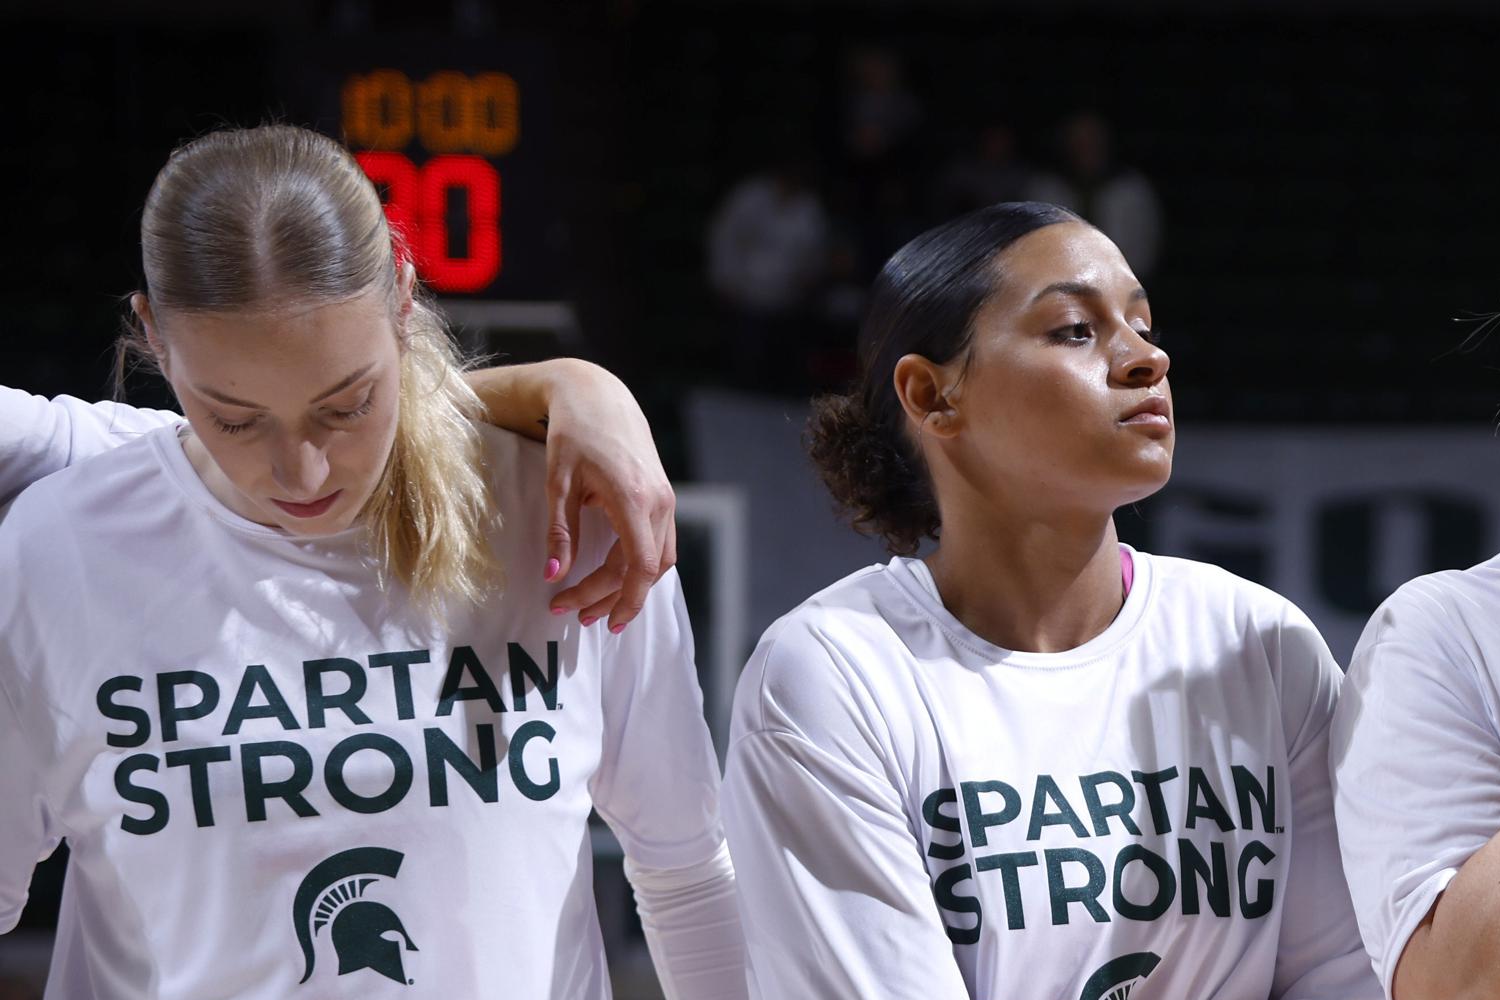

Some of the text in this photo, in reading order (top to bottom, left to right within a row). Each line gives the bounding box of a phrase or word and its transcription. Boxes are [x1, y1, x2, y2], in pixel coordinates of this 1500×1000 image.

[96, 641, 559, 747] SPARTAN
[114, 720, 561, 835] STRONG
[922, 765, 1276, 859] SPARTAN
[934, 838, 1276, 944] STRONG
